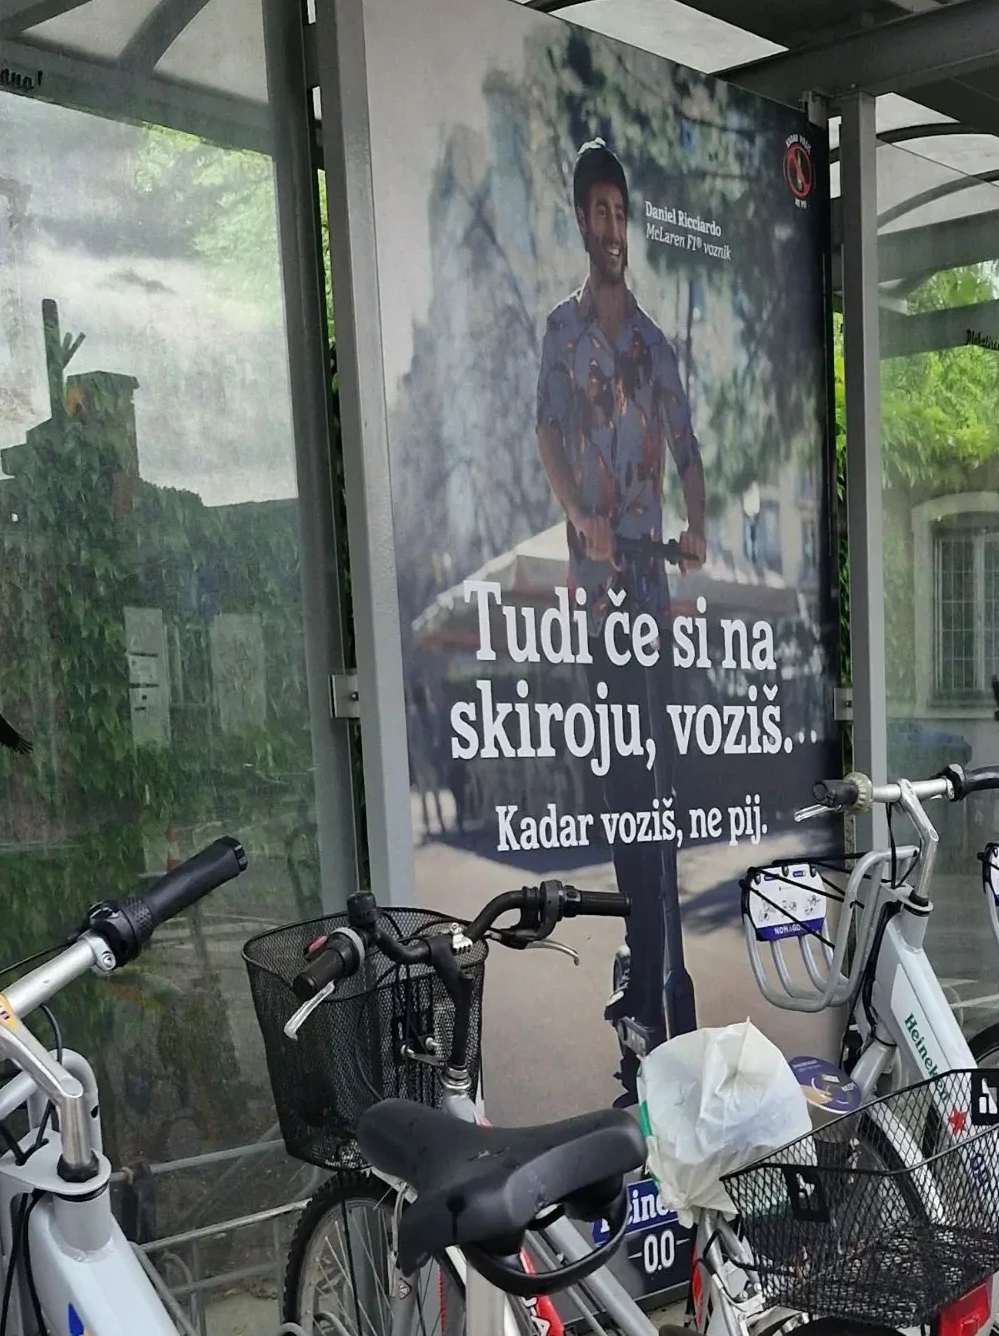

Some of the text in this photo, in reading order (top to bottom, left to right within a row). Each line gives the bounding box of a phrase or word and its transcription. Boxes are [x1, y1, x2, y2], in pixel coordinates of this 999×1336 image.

[645, 200, 722, 238] Daniel Ricciardo
[645, 222, 685, 249] McLaren
[703, 241, 732, 261] voznik
[463, 579, 777, 671] Tudi če si na
[450, 679, 818, 776] skiroju, voziš...
[495, 794, 768, 851] Kadar voziš, ne pij.
